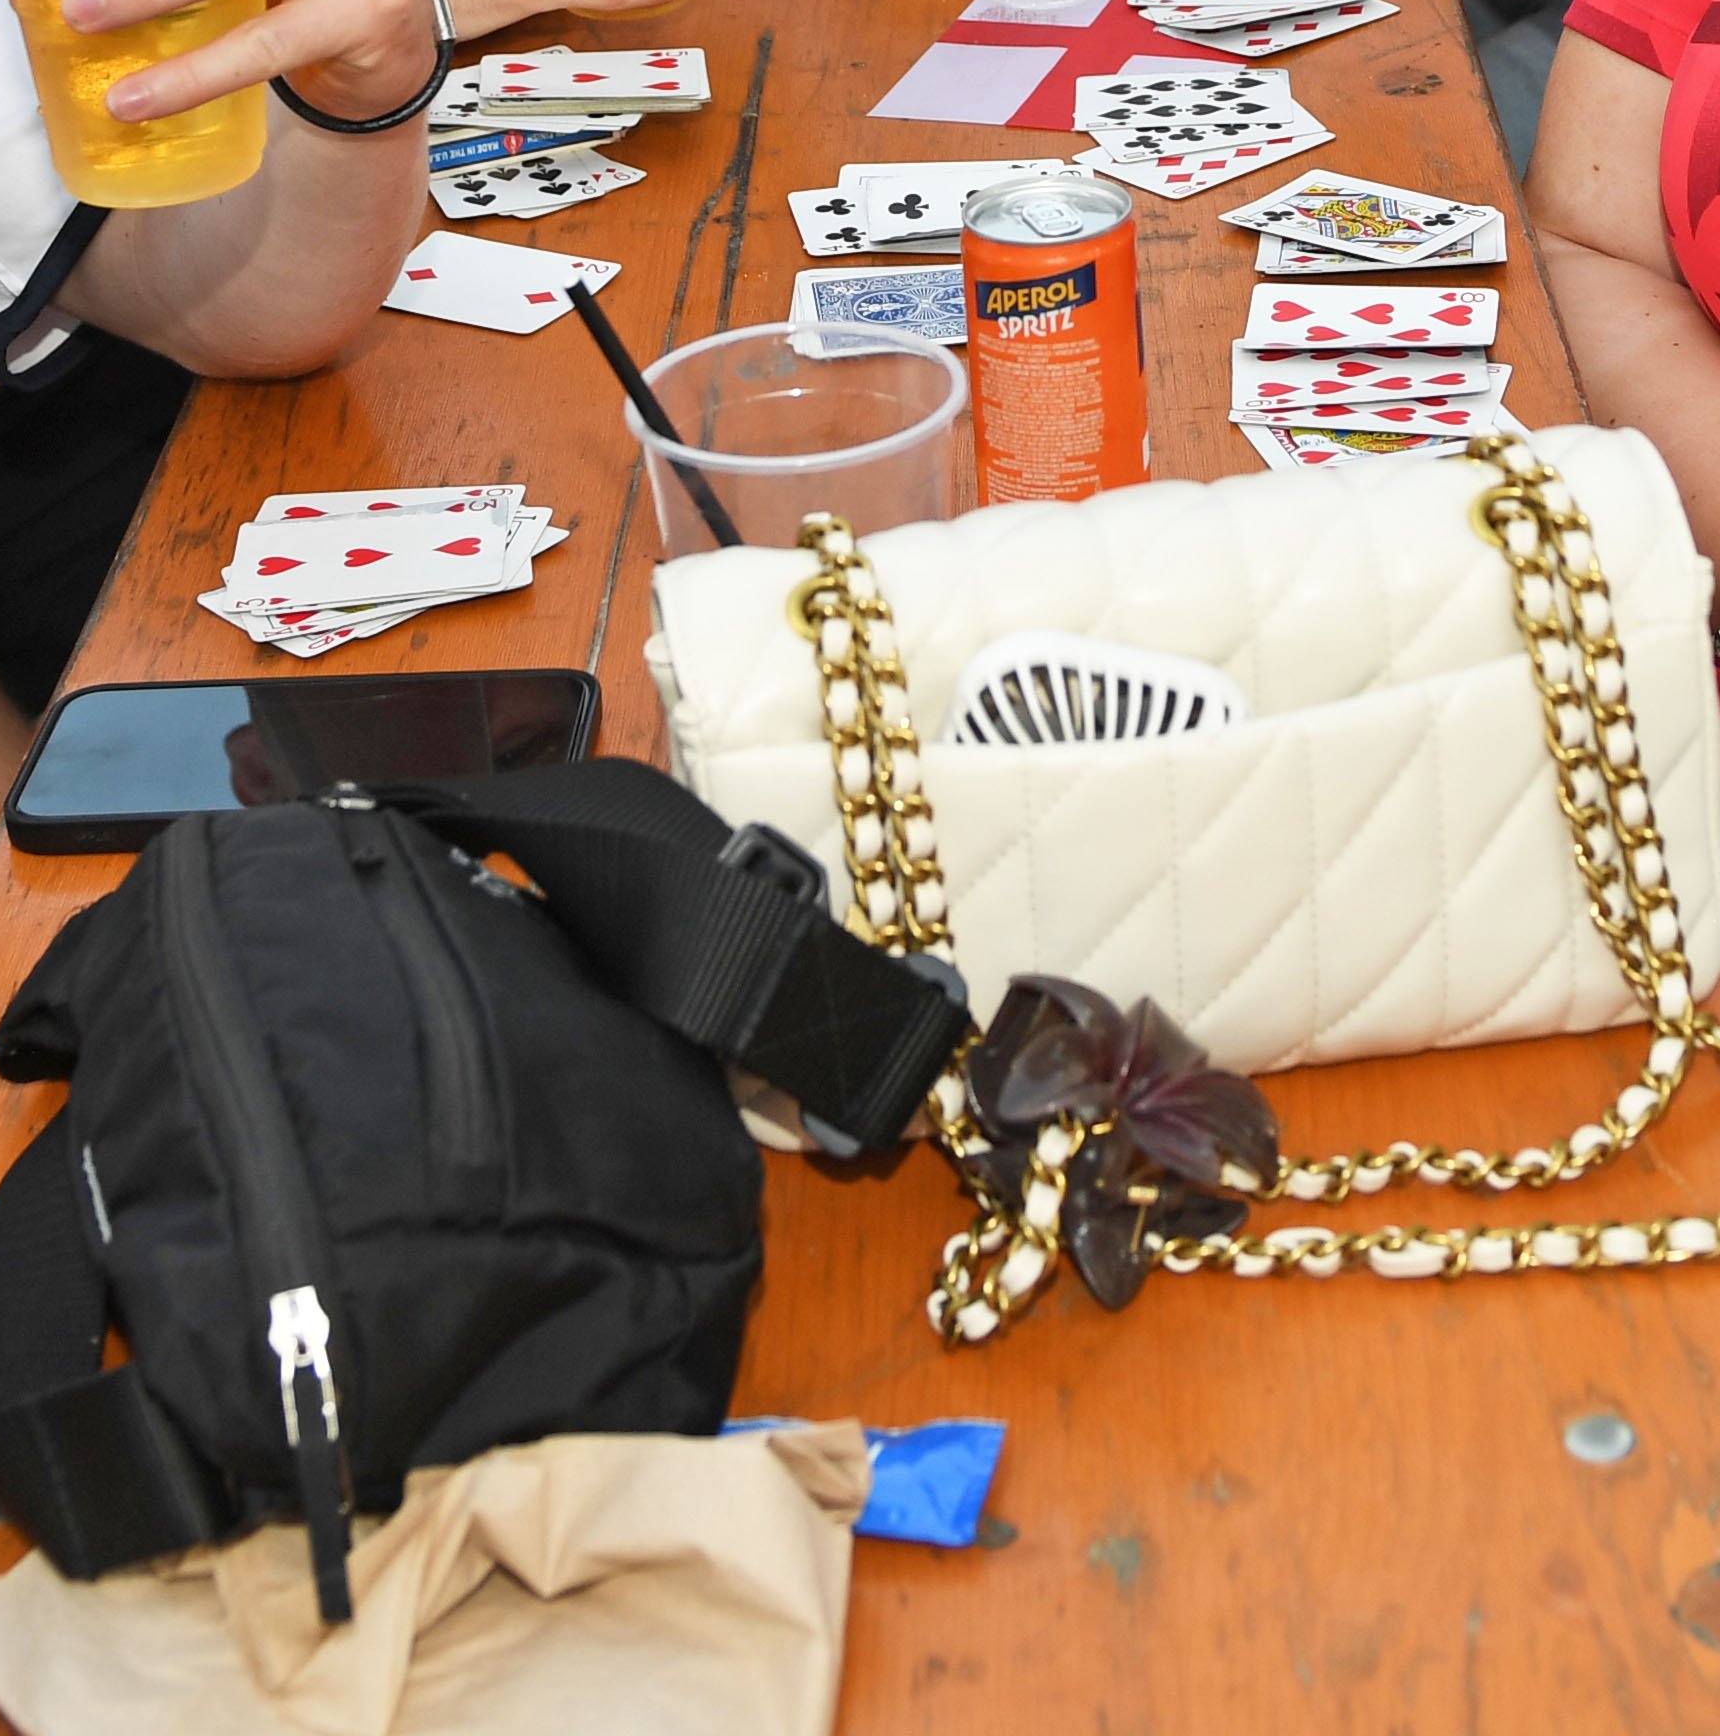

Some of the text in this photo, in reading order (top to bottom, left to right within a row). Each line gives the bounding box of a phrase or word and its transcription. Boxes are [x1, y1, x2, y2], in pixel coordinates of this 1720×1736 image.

[448, 147, 466, 161] THE
[466, 145, 477, 158] IN
[476, 141, 500, 156] MADE
[1466, 208, 1487, 218] Q
[584, 263, 610, 274] 2
[986, 278, 1082, 314] APEROL
[1460, 292, 1486, 304] 8
[997, 305, 1075, 339] SPRITZ
[1245, 399, 1272, 408] 9
[485, 487, 513, 497] 6
[468, 498, 498, 512] 3
[235, 597, 266, 609] 3
[264, 626, 293, 639] K
[307, 634, 334, 650] Q
